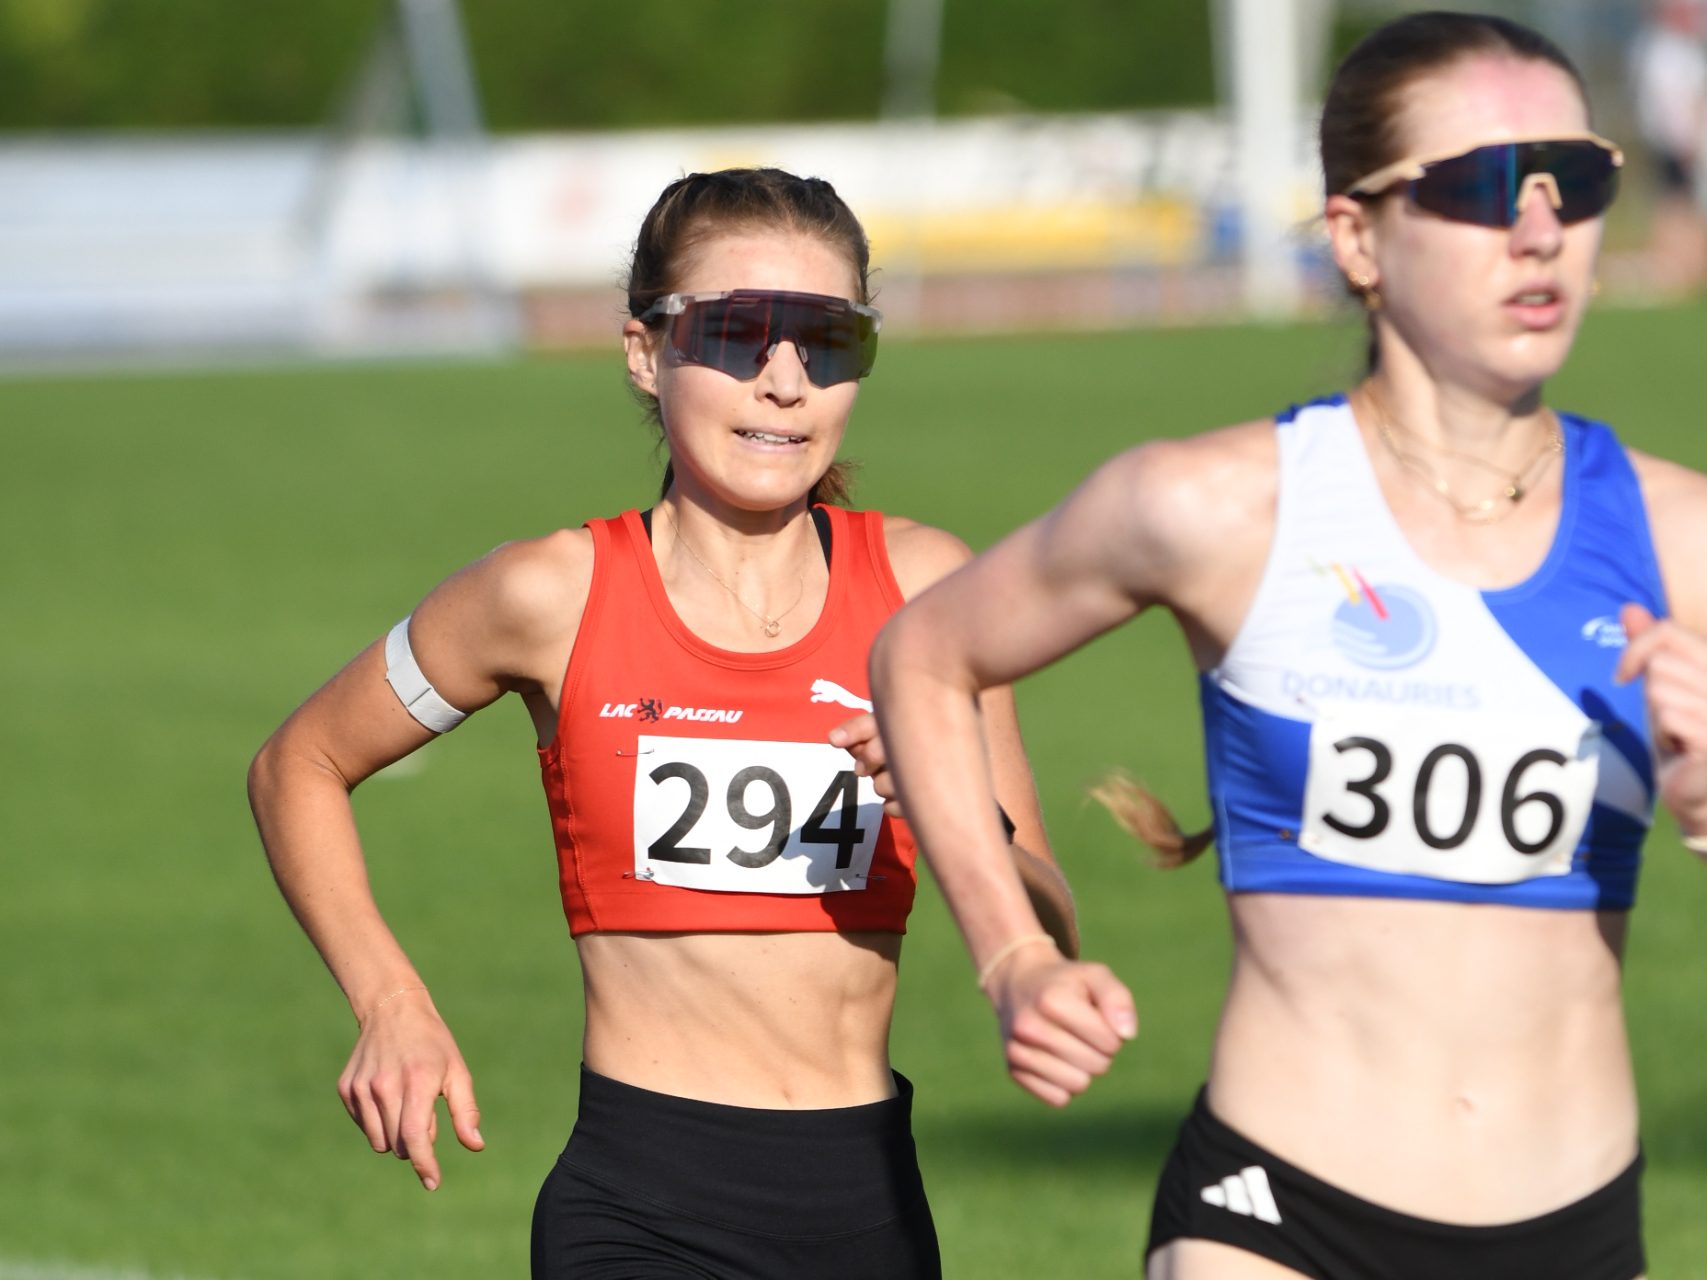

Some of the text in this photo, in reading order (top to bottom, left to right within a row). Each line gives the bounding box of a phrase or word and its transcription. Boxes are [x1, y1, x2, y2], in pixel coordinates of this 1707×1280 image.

[600, 703, 743, 724] LAC PASSAU
[1281, 671, 1480, 709] DONAURIES
[648, 762, 865, 870] 294
[1322, 736, 1568, 855] 306
